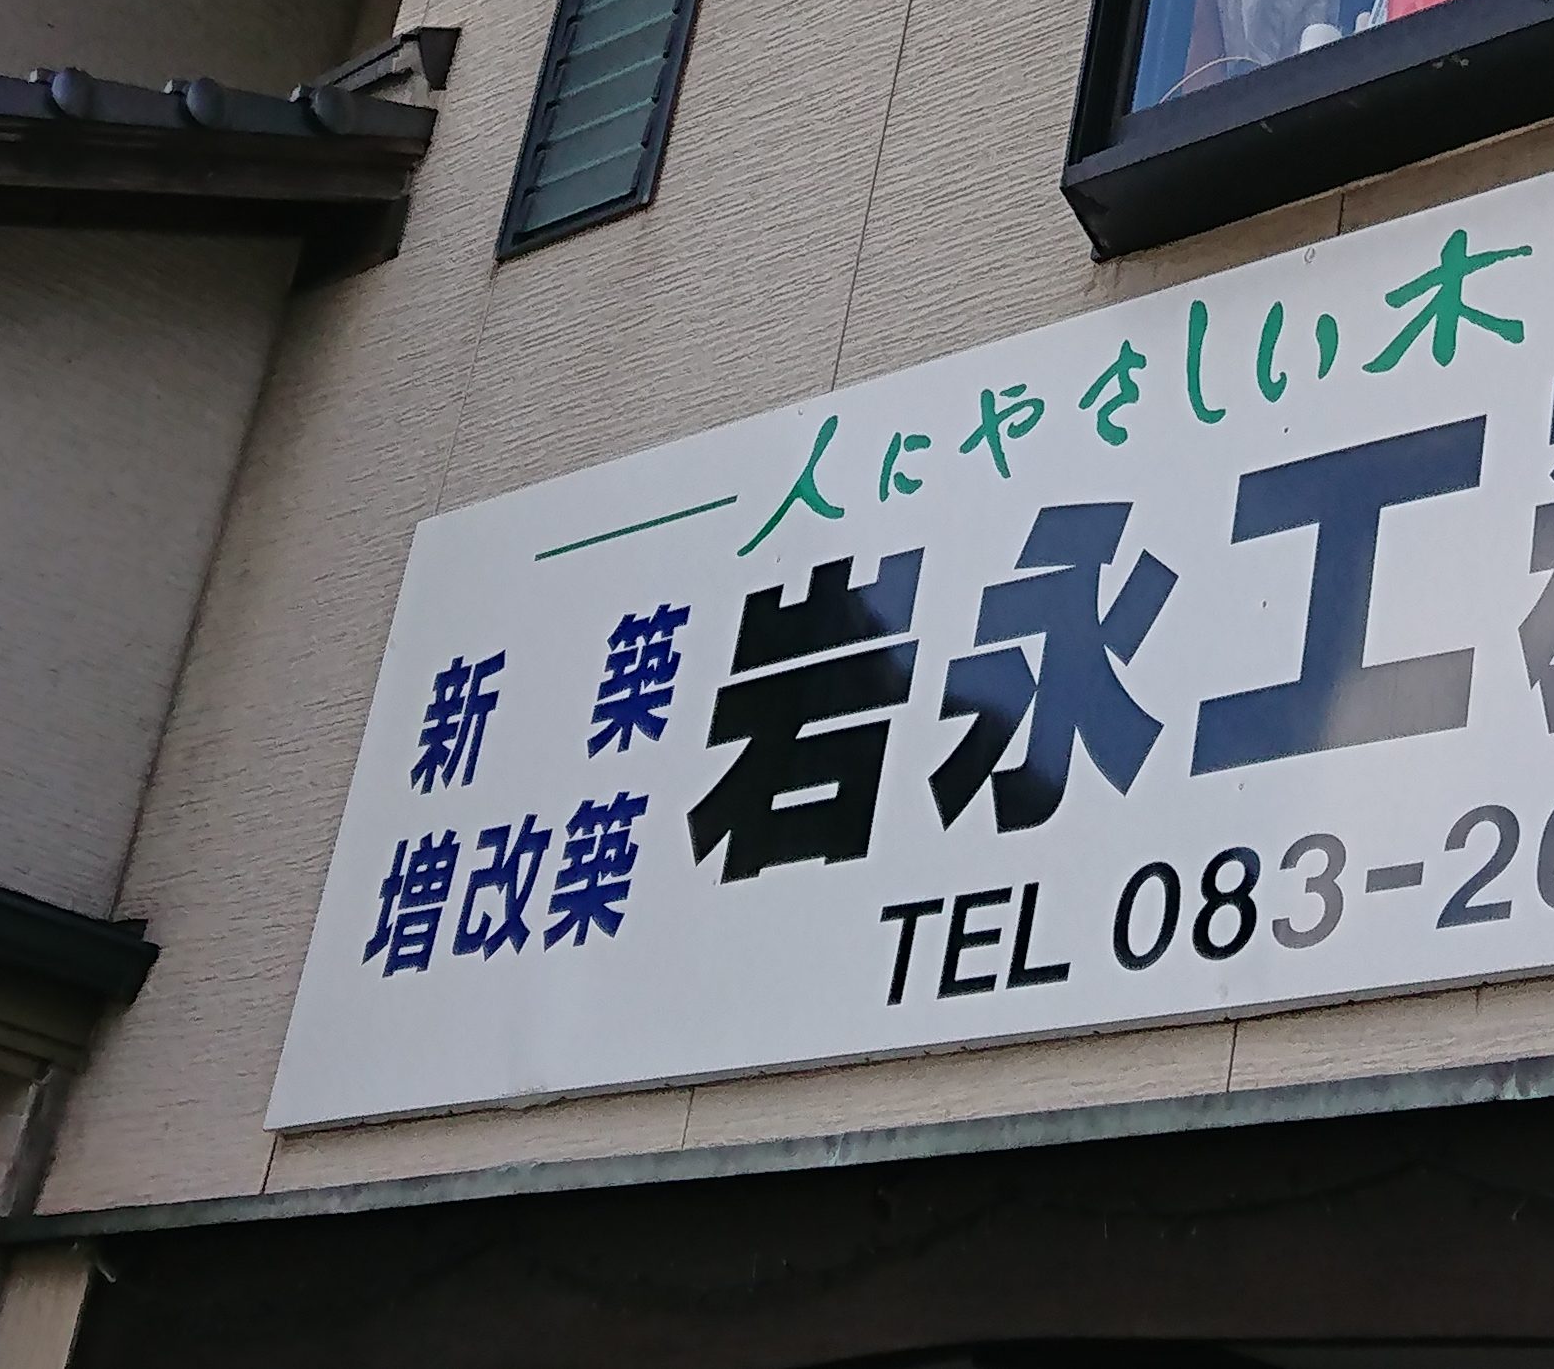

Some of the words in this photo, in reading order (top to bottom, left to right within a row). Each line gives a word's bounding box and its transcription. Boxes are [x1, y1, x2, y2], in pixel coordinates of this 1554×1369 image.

[360, 790, 650, 979] 増改築
[879, 881, 1072, 1007] TEL
